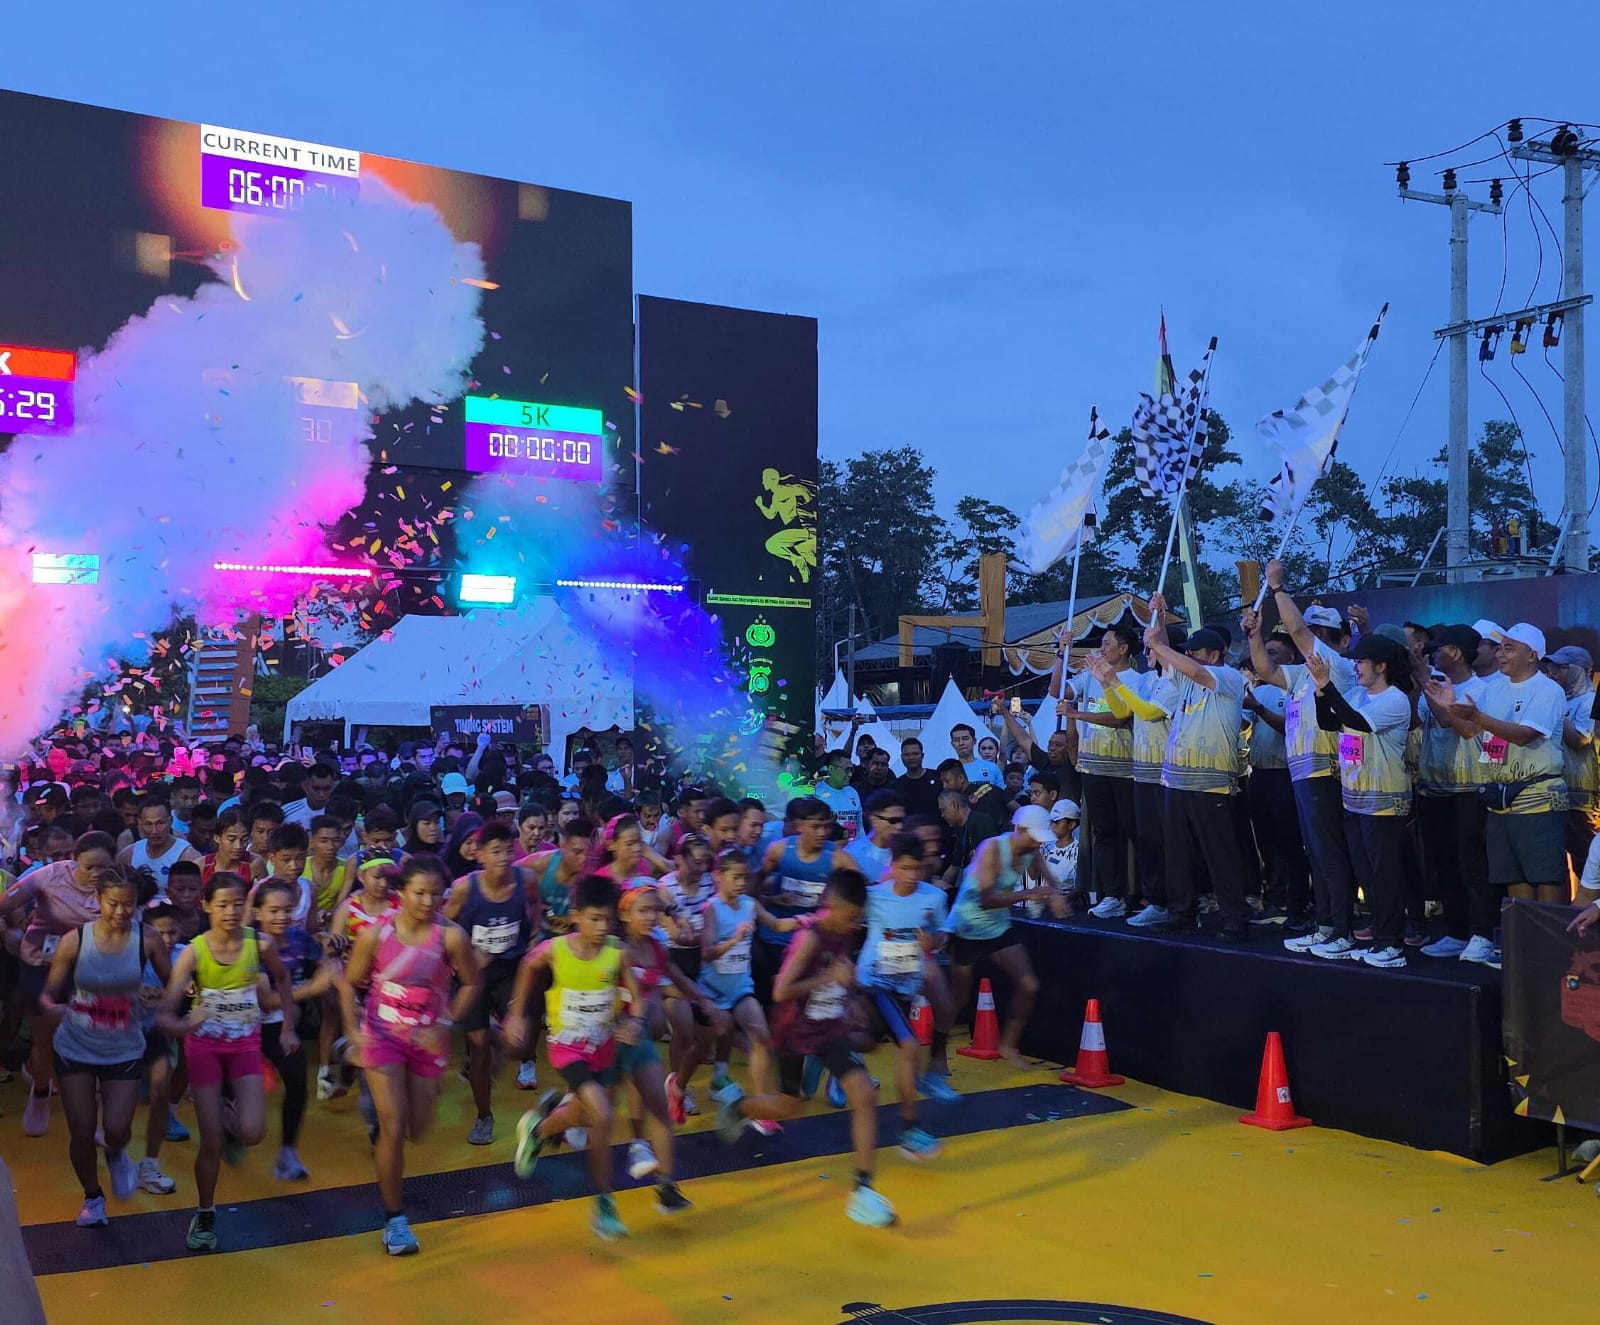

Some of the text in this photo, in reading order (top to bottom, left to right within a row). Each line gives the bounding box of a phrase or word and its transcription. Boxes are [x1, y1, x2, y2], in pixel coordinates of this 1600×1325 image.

[203, 133, 358, 173] CURRENT TIME
[520, 404, 551, 427] 5K
[488, 432, 591, 465] 00:00:00
[454, 718, 482, 733] TIMING
